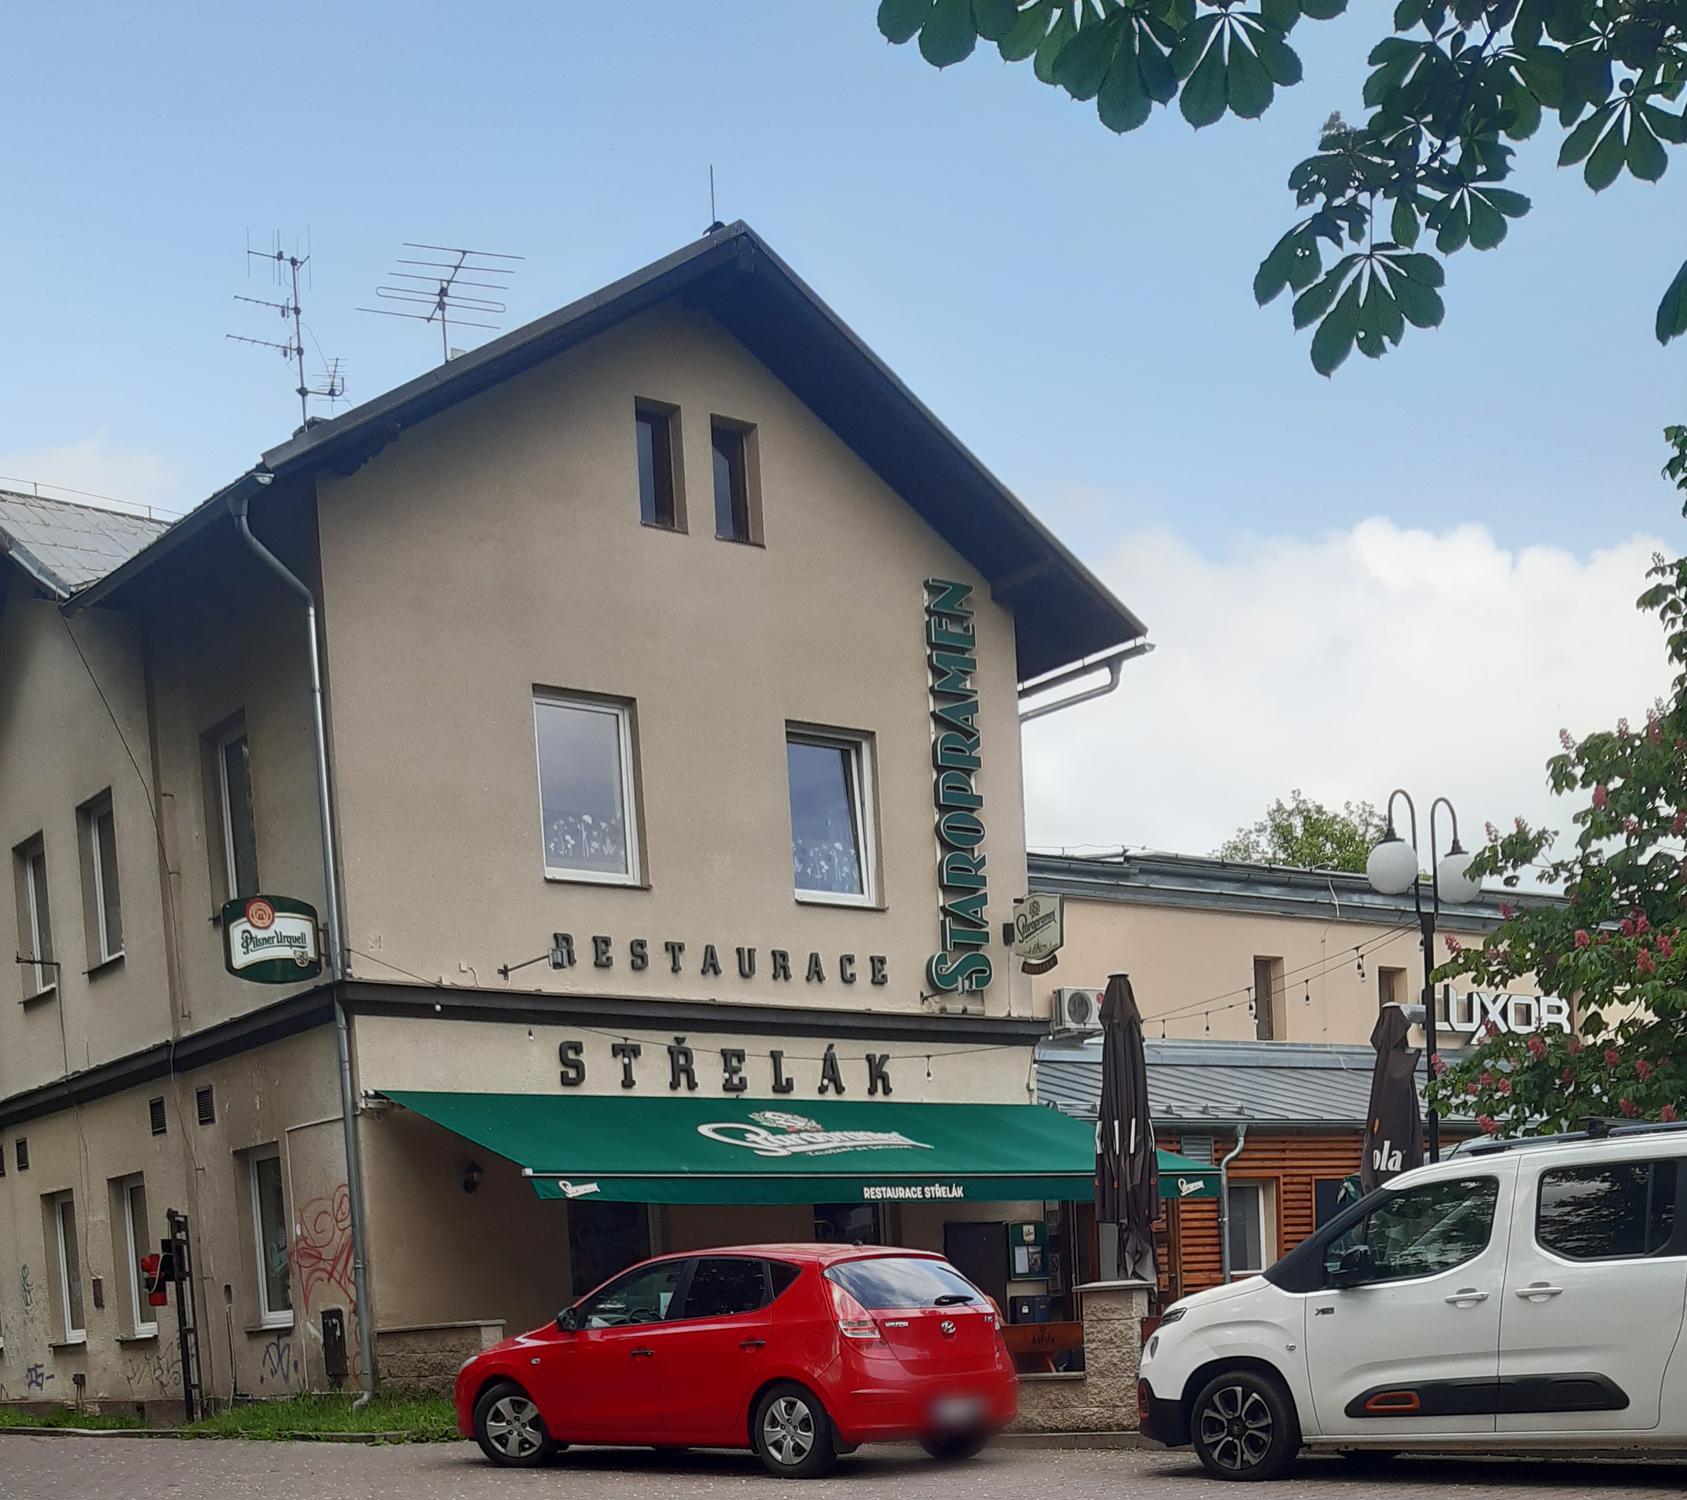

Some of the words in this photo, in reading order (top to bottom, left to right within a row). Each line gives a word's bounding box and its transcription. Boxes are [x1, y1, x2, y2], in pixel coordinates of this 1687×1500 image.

[925, 577, 994, 992] STAROPRAMEN
[241, 929, 276, 955] Pilsner
[275, 929, 307, 949] Urquell
[553, 932, 888, 985] RESTAURACE
[558, 1036, 893, 1096] STŘELÁK
[863, 1186, 923, 1199] RESTAURACE
[924, 1183, 964, 1199] STŘELÁK
